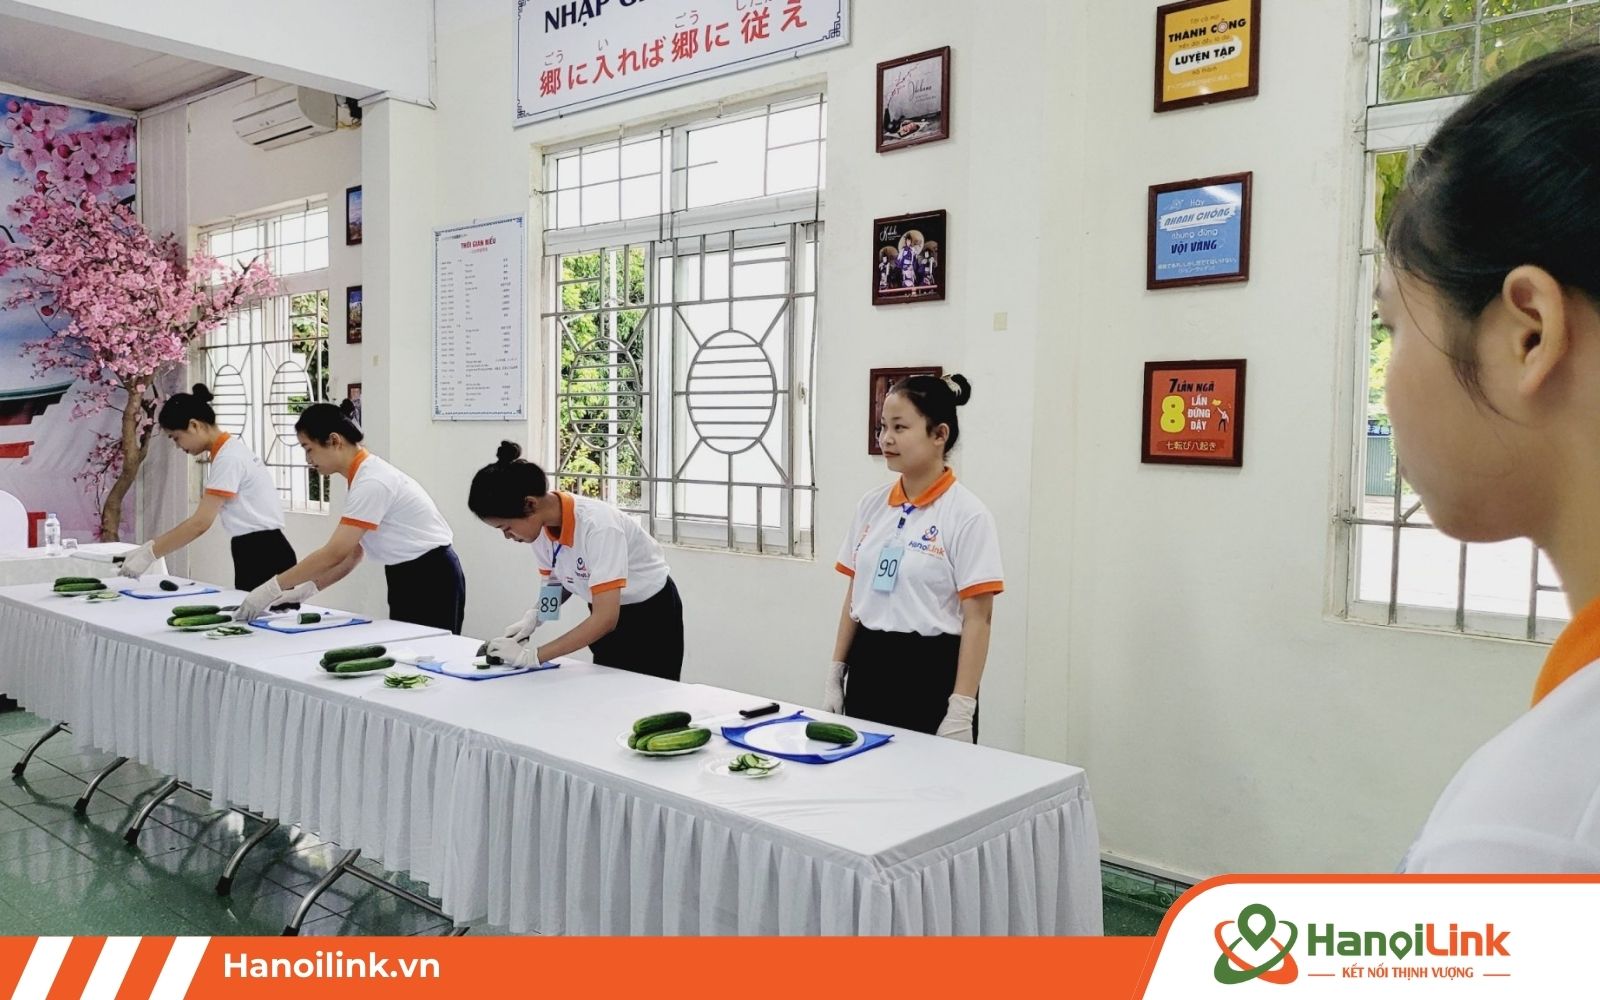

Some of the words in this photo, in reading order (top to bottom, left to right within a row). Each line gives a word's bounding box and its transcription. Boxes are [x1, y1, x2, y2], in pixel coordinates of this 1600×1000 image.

[1175, 50, 1210, 66] LUYỆN
[1213, 45, 1236, 59] TẬP
[1171, 241, 1188, 255] VỘI
[1169, 379, 1179, 393] 7
[1160, 395, 1186, 433] 8
[877, 558, 899, 578] 90
[540, 597, 559, 613] 89
